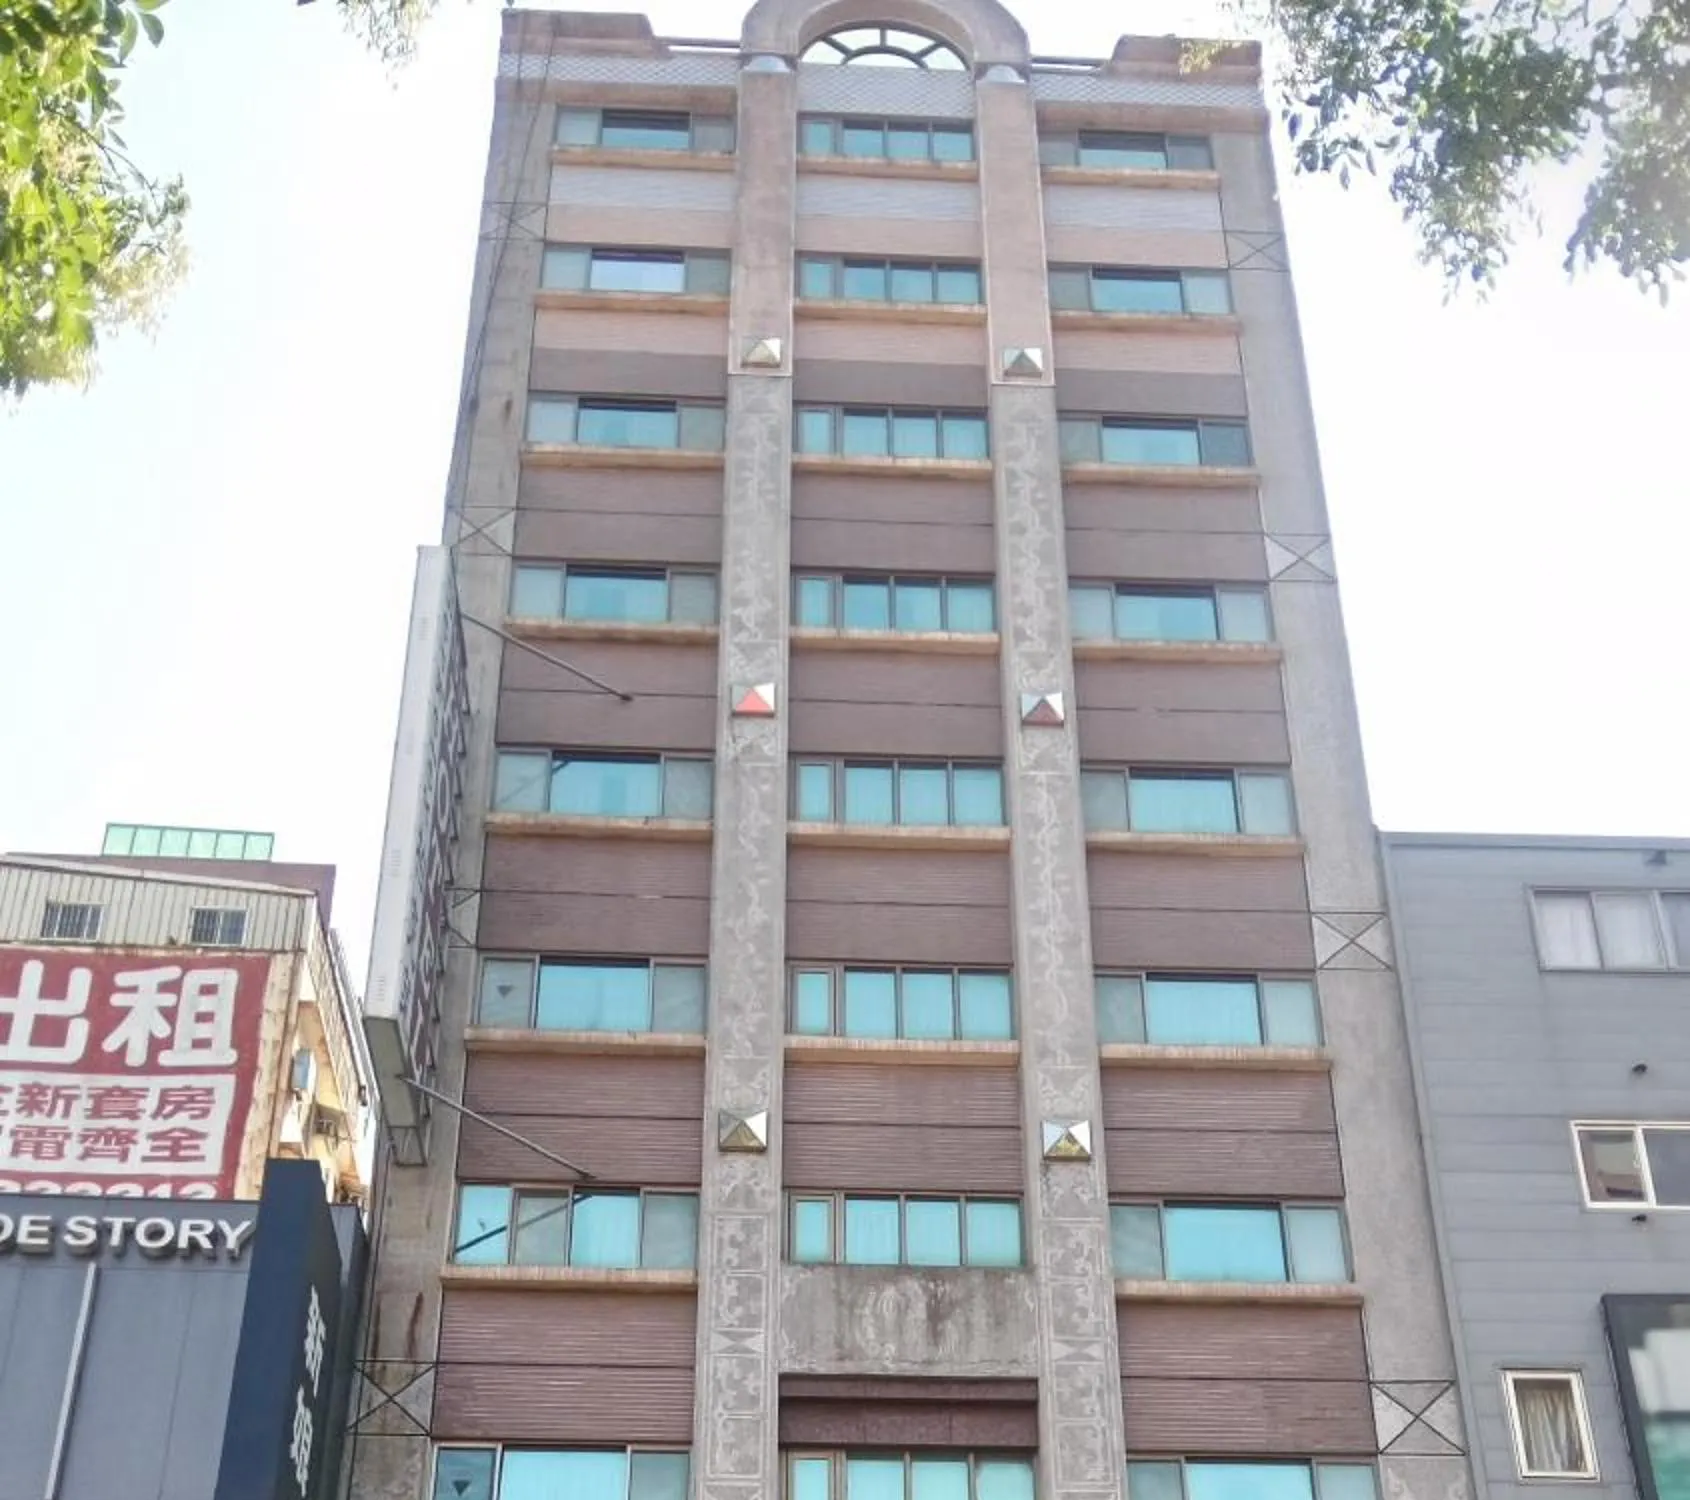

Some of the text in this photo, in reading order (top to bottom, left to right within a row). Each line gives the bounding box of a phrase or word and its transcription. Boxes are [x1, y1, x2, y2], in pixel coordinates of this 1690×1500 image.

[0, 959, 239, 1067] 出租
[0, 1124, 208, 1163] 電齊全
[63, 1216, 252, 1252] STORY
